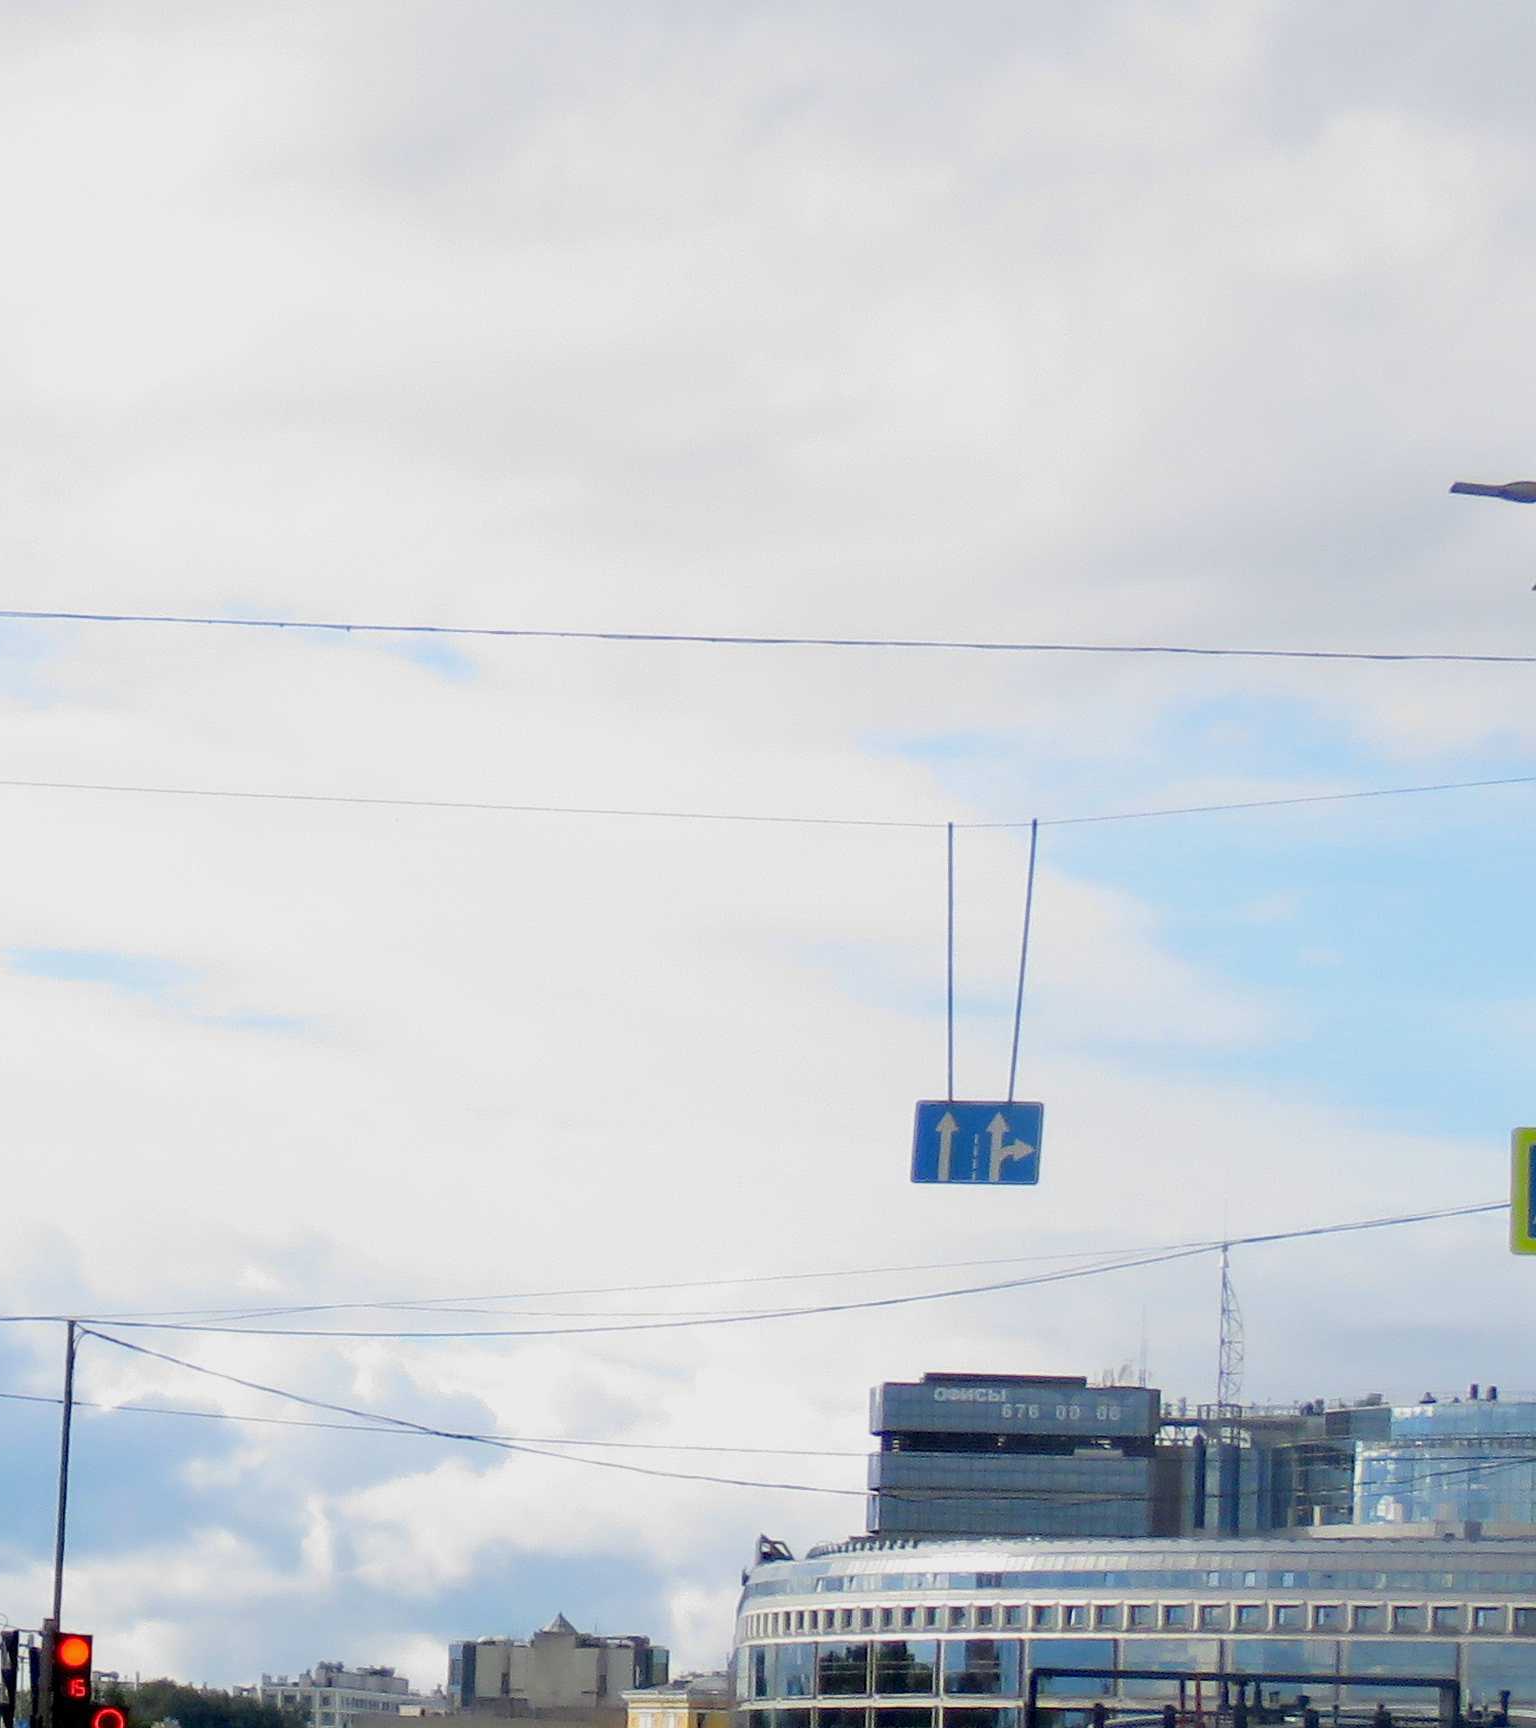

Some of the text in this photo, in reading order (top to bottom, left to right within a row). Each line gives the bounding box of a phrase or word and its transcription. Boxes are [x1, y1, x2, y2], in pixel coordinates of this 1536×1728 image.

[933, 1386, 1007, 1403] ОФИСЫ
[1000, 1403, 1040, 1419] 676
[70, 1679, 86, 1697] 15
